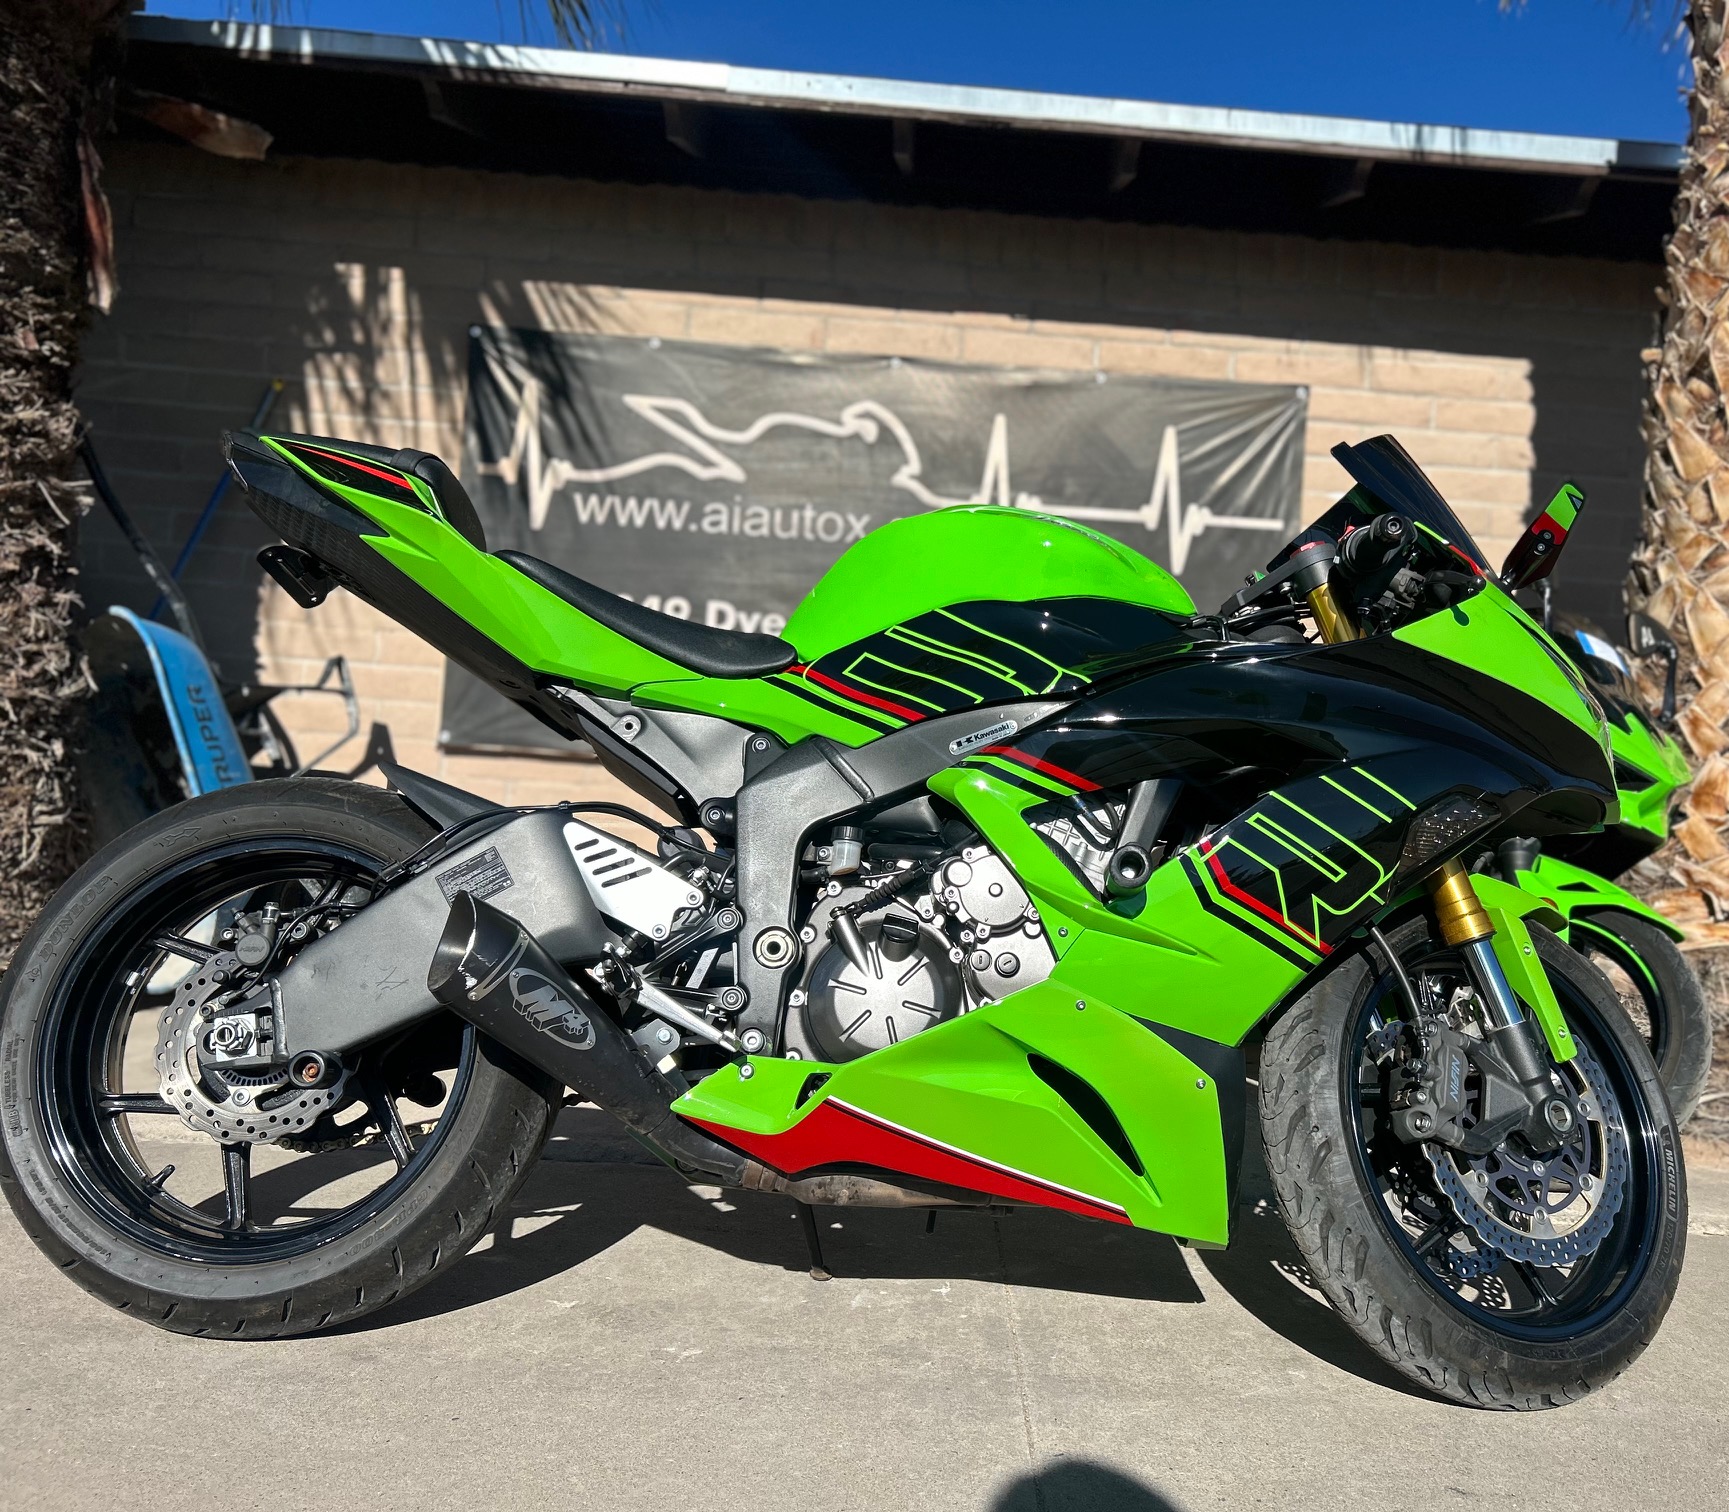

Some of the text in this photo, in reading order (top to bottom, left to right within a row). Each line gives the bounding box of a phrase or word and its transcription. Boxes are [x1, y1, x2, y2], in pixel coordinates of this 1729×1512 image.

[573, 492, 873, 543] www.aiautox
[187, 684, 233, 784] RUPER
[974, 722, 1010, 741] Kawasaki
[5, 1039, 13, 1062] RADIAL
[1665, 1148, 1676, 1212] MICHELIN
[1663, 1222, 1674, 1254] 120/70
